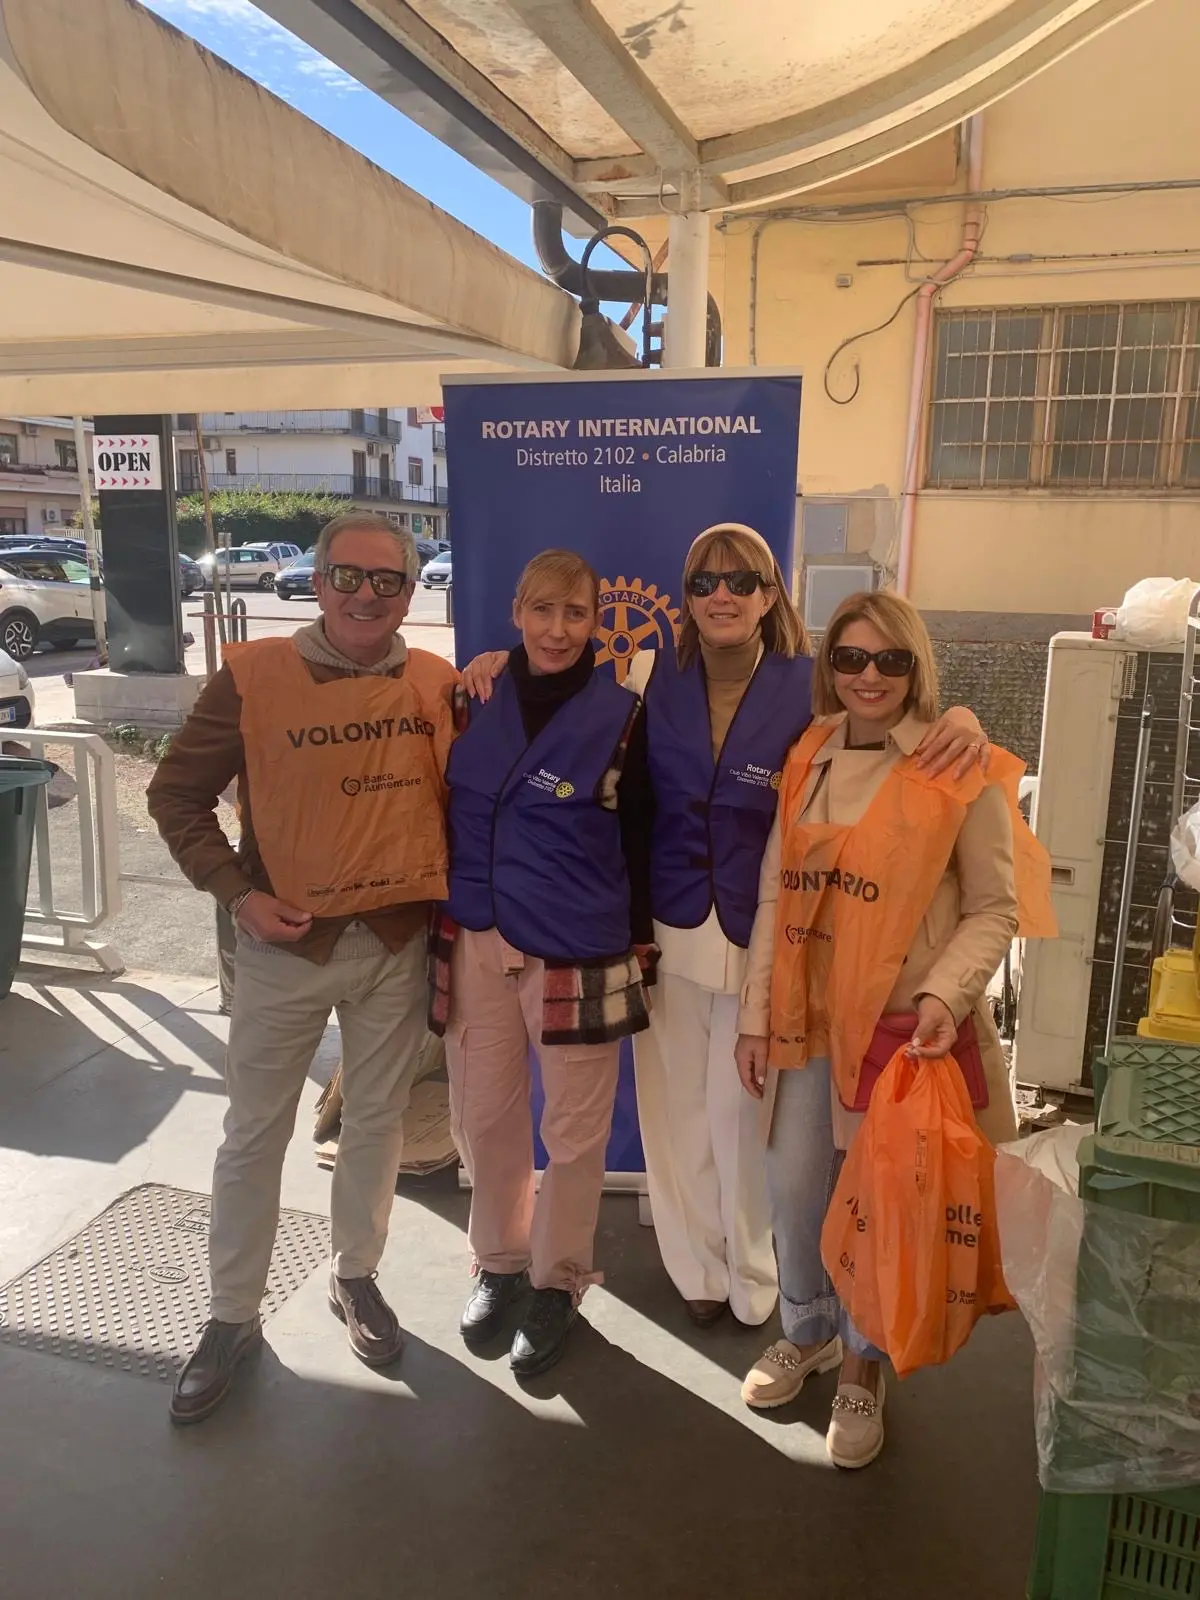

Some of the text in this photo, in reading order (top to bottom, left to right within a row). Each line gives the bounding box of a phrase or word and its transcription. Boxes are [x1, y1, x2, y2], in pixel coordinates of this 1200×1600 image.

[482, 415, 761, 439] ROTARY INTERNATIONAL
[98, 452, 151, 471] OPEN
[516, 444, 726, 466] Distretto 2102 Calabria
[600, 474, 642, 493] Italia
[598, 591, 649, 606] OTARY
[538, 768, 560, 783] Rotary
[746, 764, 771, 777] Rotary
[781, 867, 879, 902] OLONTARIO
